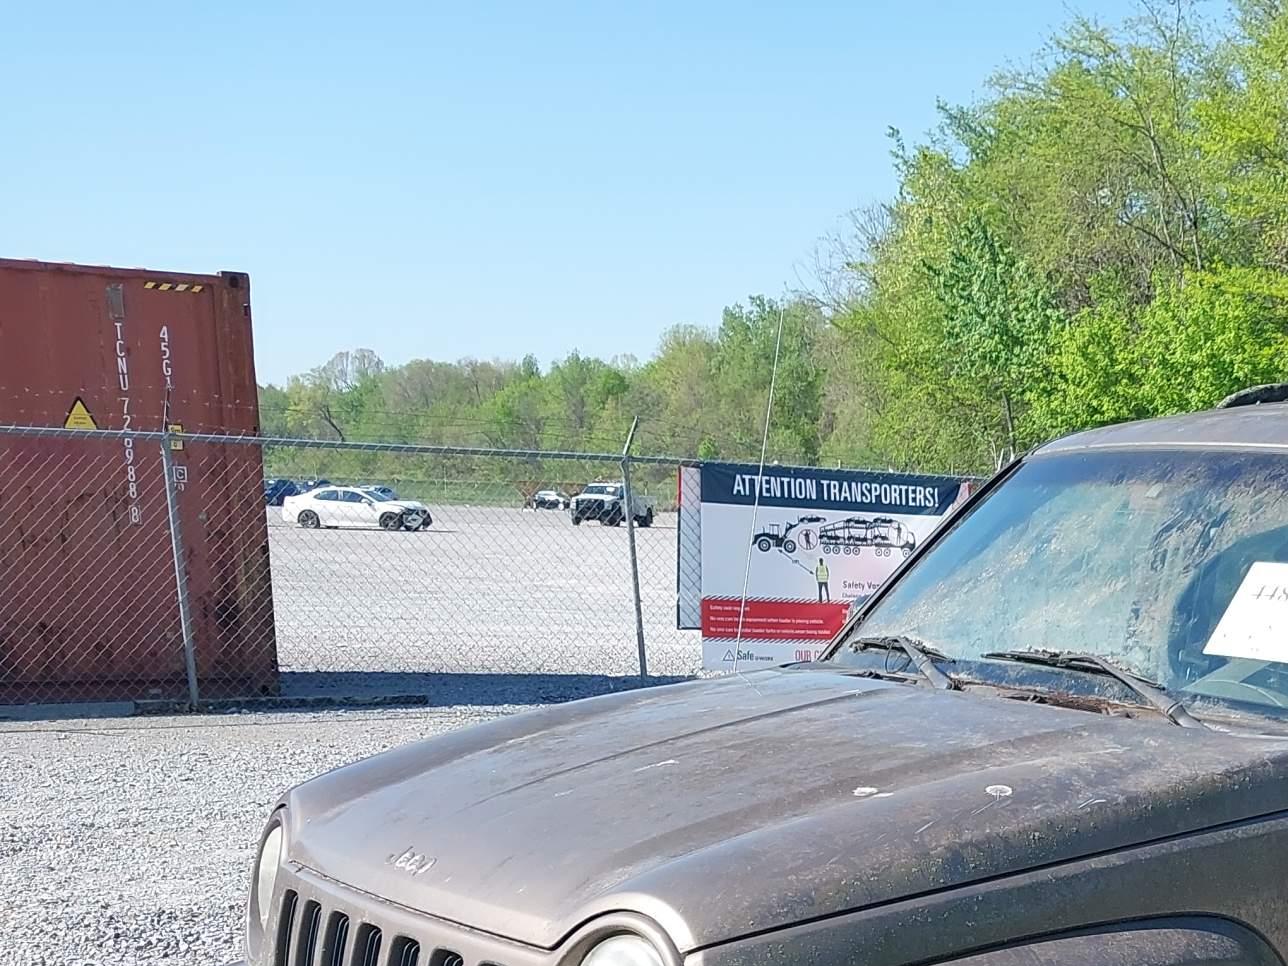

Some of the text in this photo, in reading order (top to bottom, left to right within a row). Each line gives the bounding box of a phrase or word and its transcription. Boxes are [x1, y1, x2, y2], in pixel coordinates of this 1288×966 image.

[114, 322, 129, 391] TCNU
[732, 473, 940, 508] ATTENTION TRANSPORTERS!
[842, 580, 865, 592] Safety
[736, 650, 755, 661] Safe
[794, 650, 811, 662] OUR
[384, 845, 438, 877] Jeep
